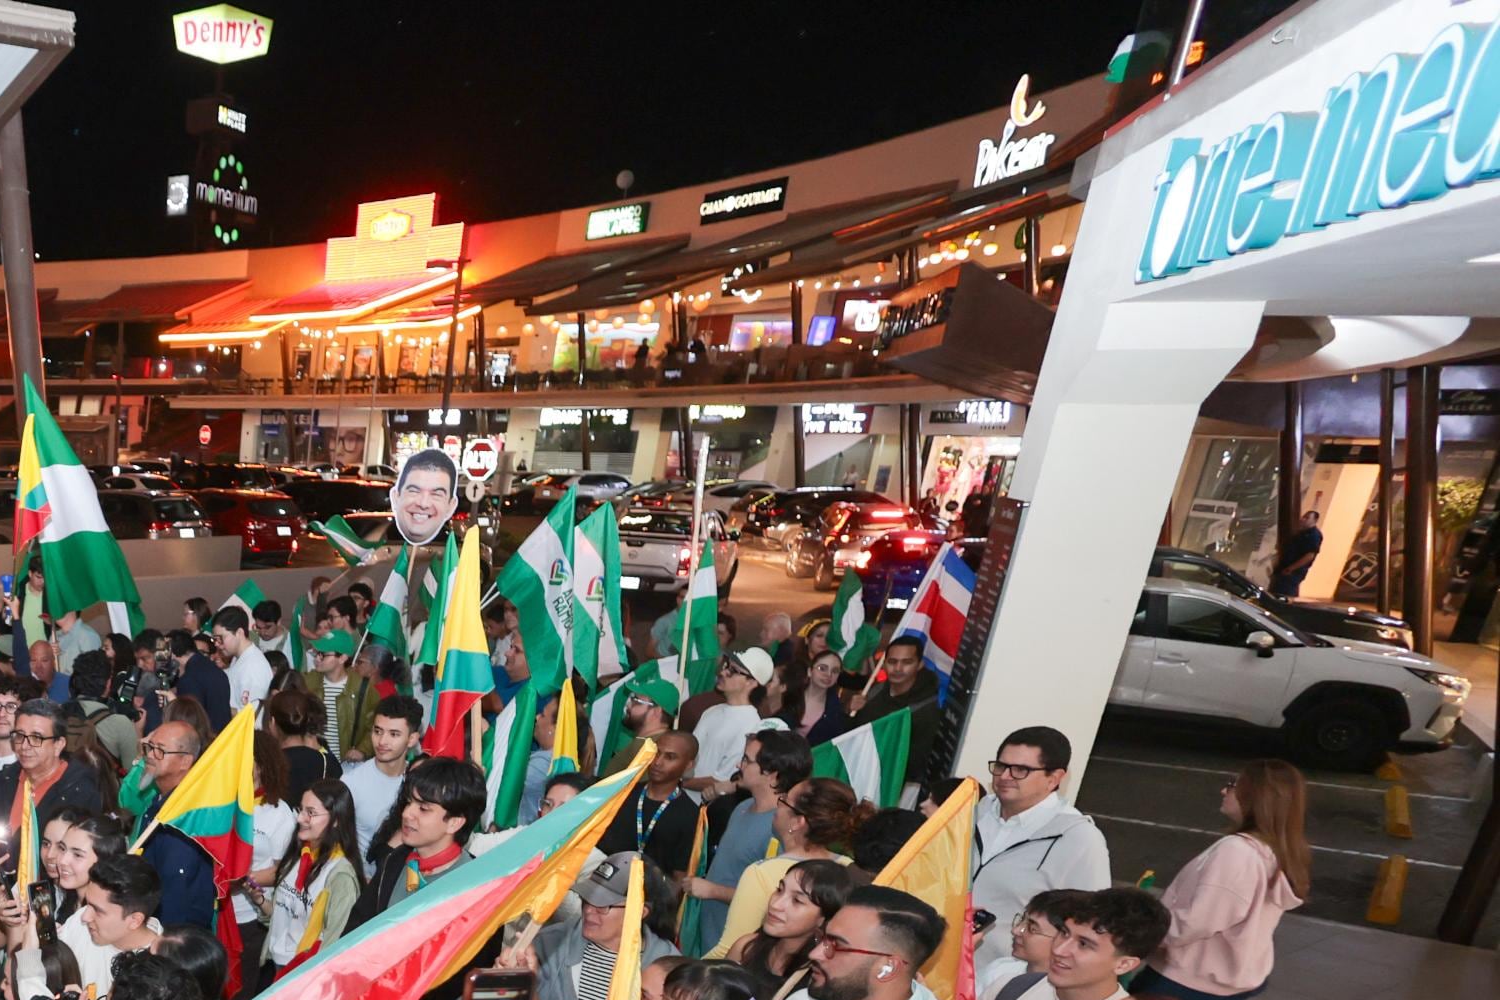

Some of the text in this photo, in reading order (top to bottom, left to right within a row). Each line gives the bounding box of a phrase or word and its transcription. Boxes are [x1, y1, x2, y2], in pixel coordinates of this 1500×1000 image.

[183, 18, 265, 49] Denny's
[1135, 112, 1308, 284] torre
[466, 449, 498, 470] ALTO
